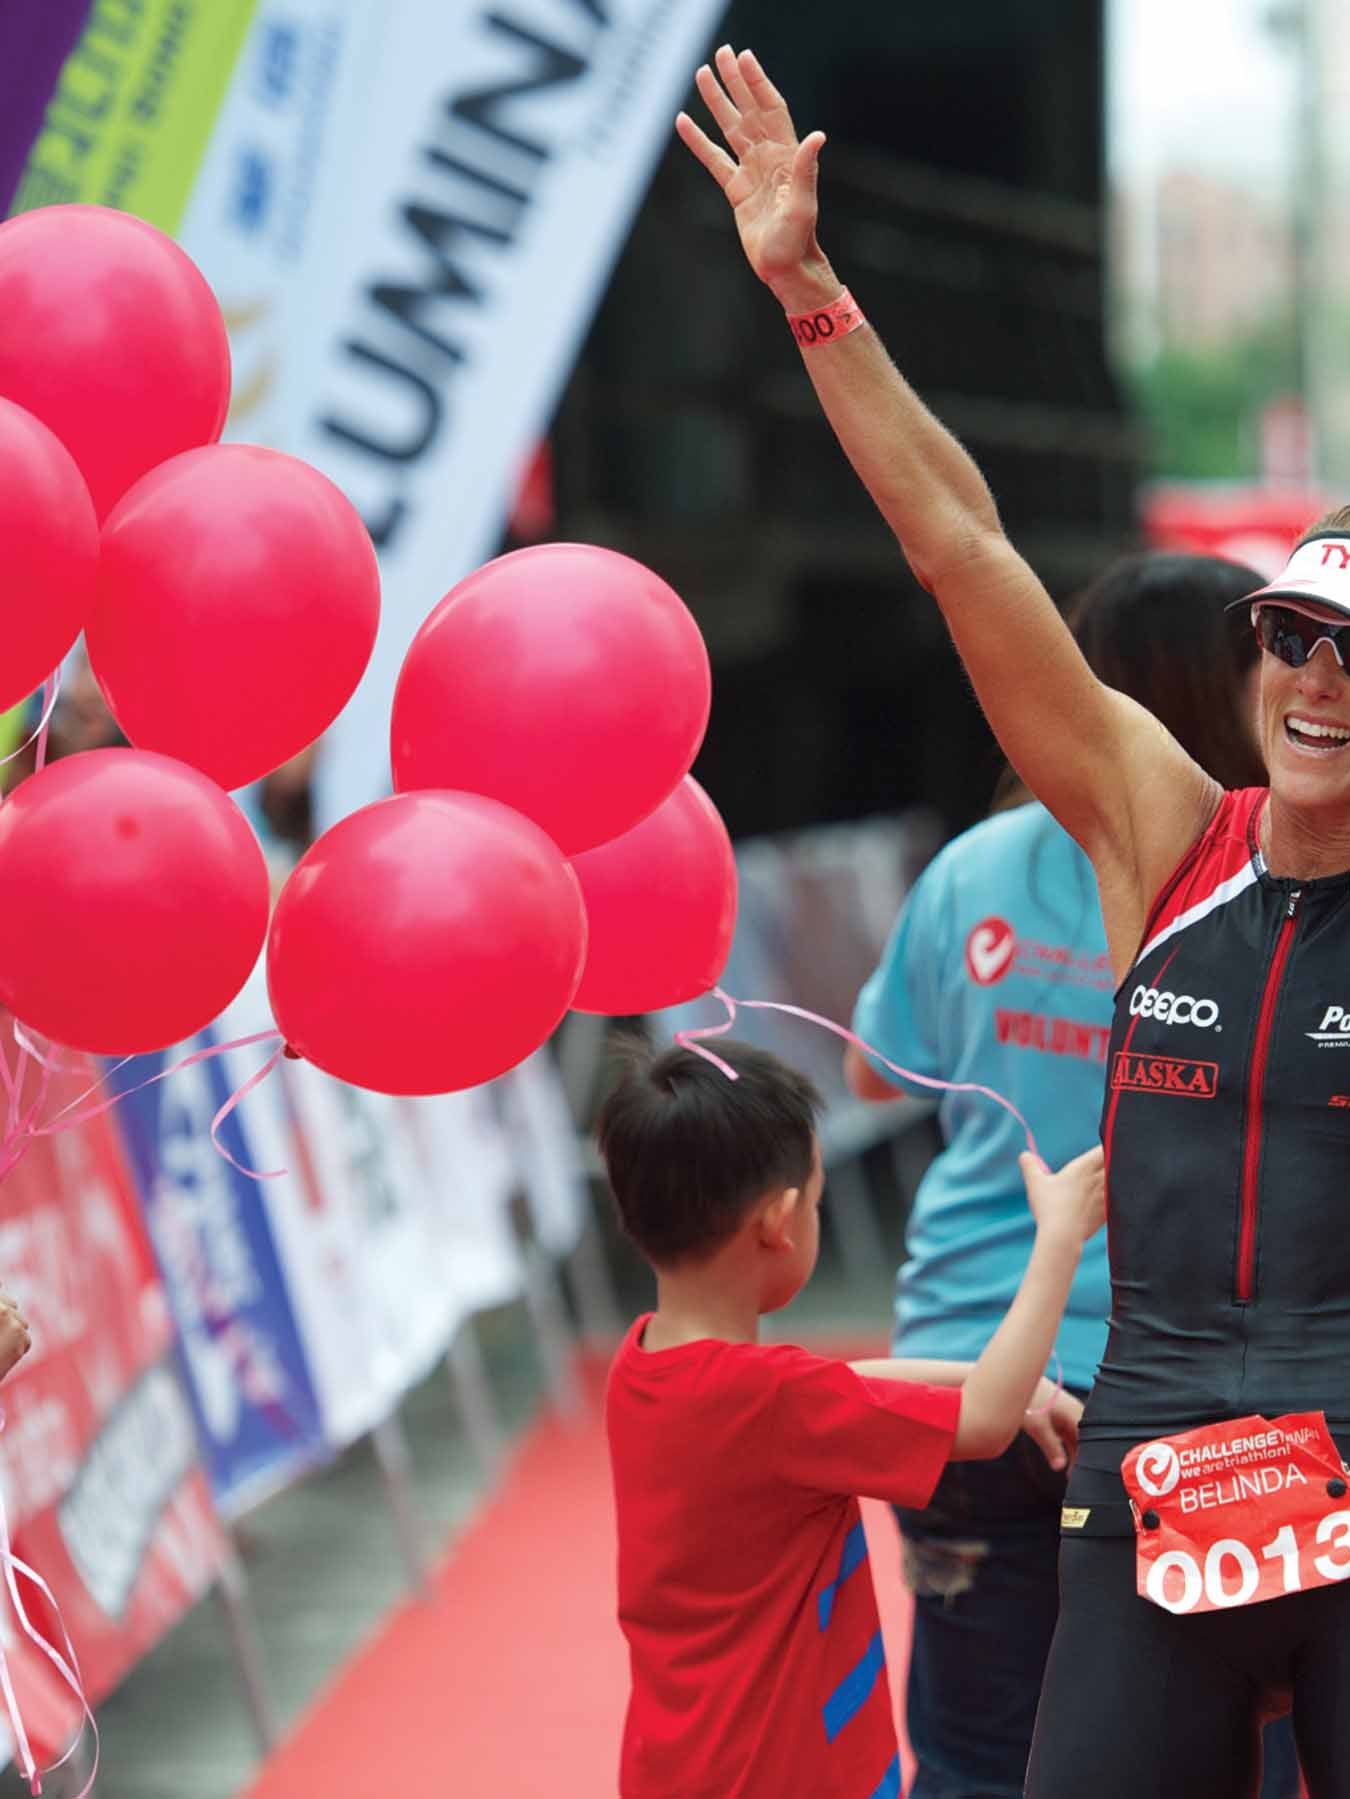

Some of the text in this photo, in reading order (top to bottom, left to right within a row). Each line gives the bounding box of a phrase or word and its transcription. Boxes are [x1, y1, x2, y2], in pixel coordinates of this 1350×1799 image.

[1114, 1056, 1210, 1092] ALASKA
[1179, 1431, 1279, 1467] CHALLENGE
[1179, 1462, 1308, 1513] BELINDA
[1181, 1466, 1201, 1479] we
[1202, 1460, 1224, 1474] are
